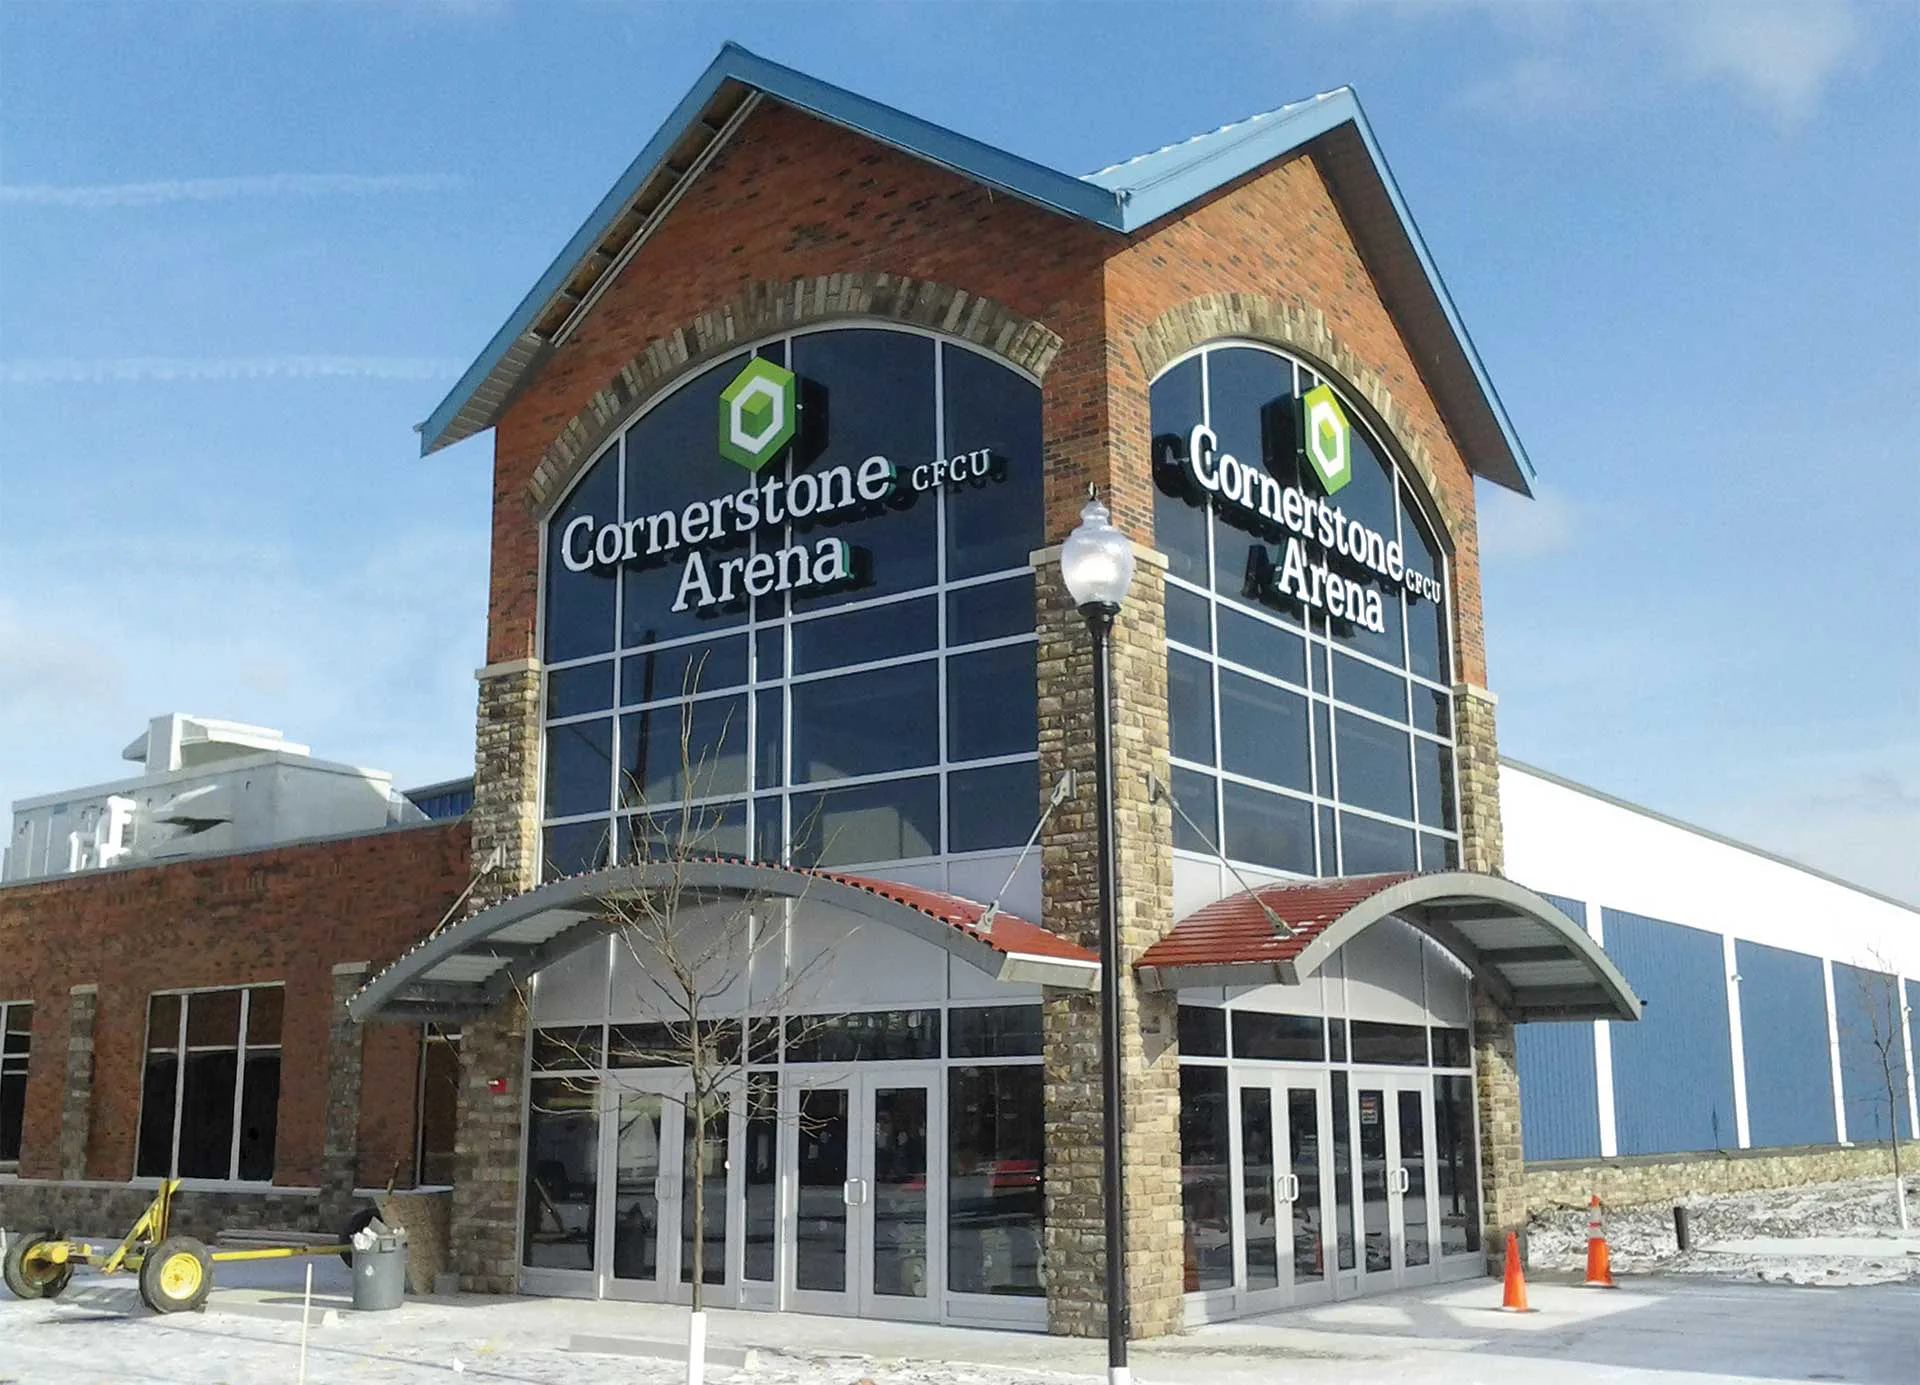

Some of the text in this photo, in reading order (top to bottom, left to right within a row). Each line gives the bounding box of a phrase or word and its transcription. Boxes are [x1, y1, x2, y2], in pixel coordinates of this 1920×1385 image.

[561, 448, 991, 572] Cornerstone CFCU
[1190, 424, 1442, 604] Cornerstone CFCU
[671, 536, 851, 612] Arena
[1278, 537, 1385, 634] Arena
